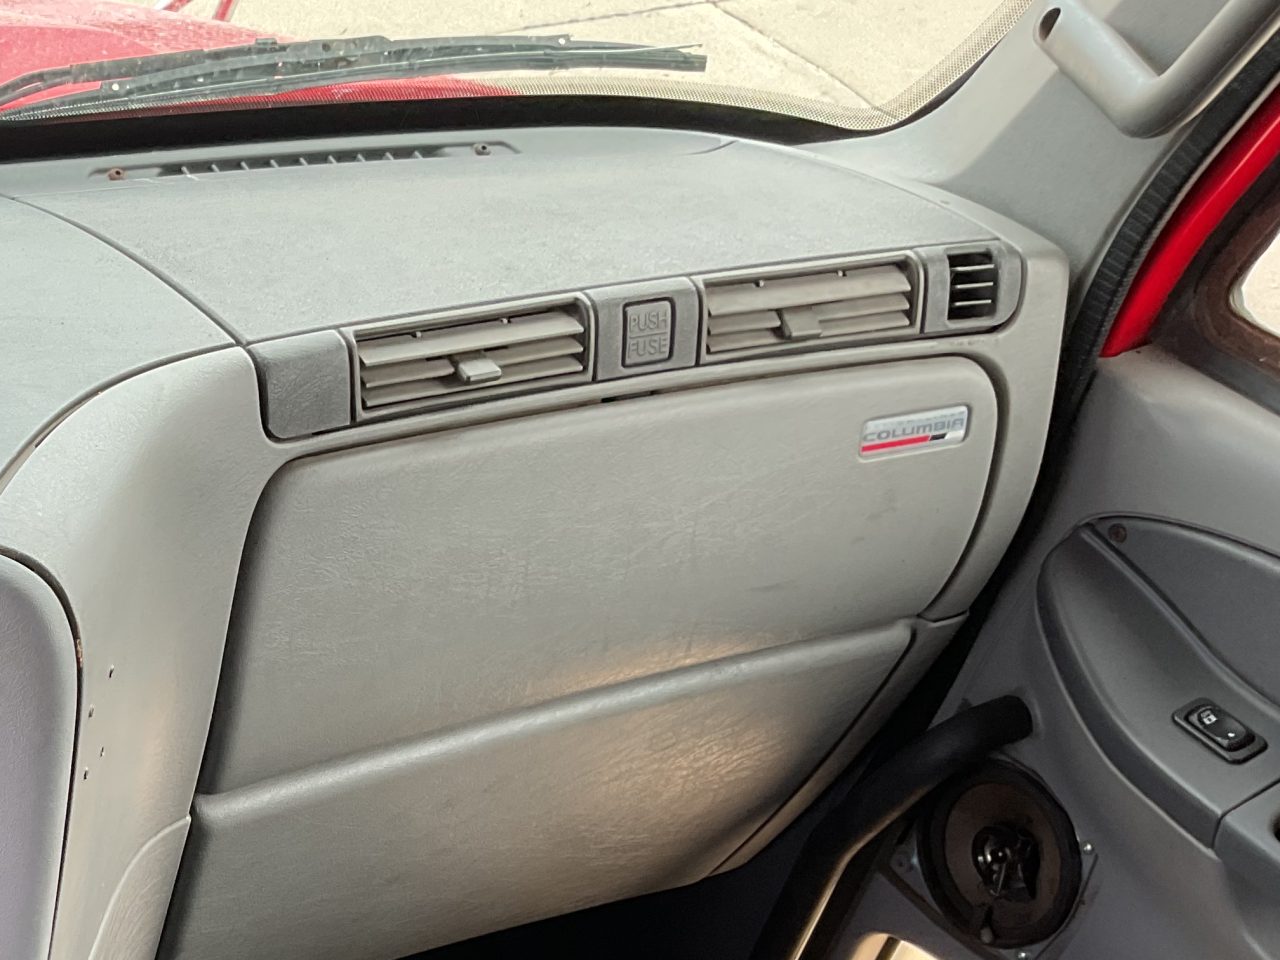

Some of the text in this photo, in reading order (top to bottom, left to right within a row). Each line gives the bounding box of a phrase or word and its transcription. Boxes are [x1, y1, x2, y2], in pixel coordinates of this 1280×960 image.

[629, 310, 668, 333] PUSH
[627, 336, 668, 359] FUSE
[863, 418, 965, 442] COLUMBIA
